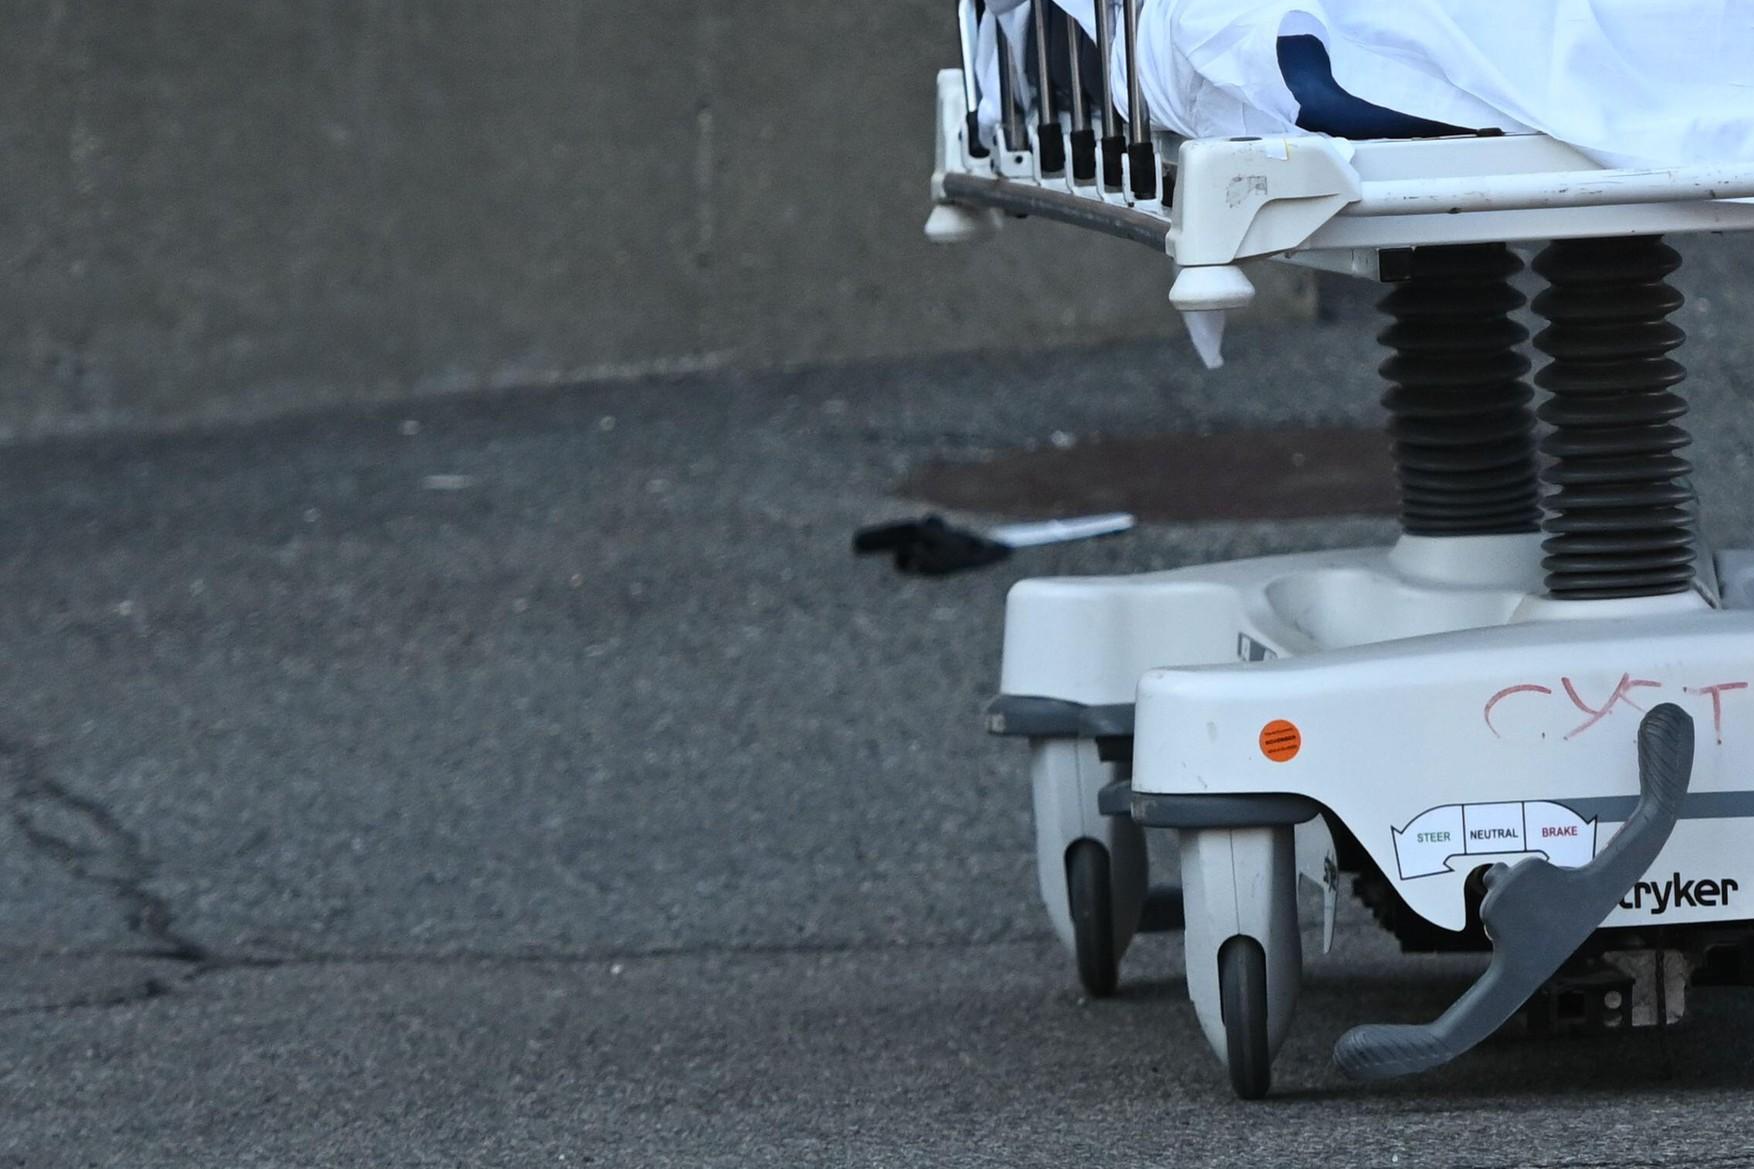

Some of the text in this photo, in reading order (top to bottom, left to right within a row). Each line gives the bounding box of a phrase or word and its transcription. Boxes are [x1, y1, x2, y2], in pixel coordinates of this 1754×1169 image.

[1417, 826, 1578, 843] STEER NEUTRAL BRAKE
[1618, 872, 1739, 915] ryker
